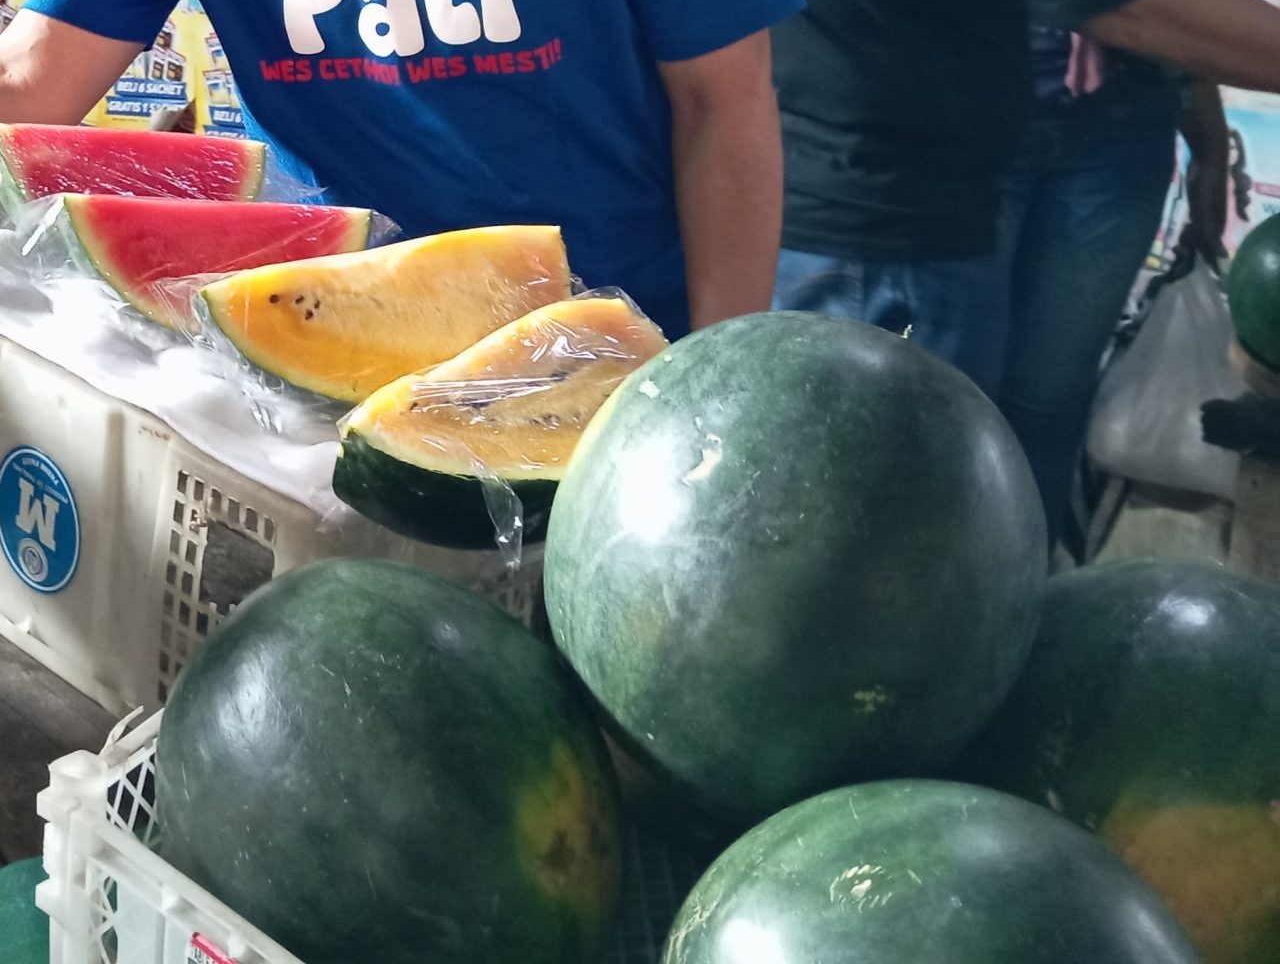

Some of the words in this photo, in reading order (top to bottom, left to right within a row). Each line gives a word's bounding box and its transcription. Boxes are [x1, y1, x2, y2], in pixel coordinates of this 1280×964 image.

[261, 60, 313, 83] WES
[406, 56, 467, 83] WES
[473, 38, 562, 75] MESTI!
[138, 82, 145, 93] 6
[145, 83, 183, 95] SACHET
[109, 100, 142, 112] GRATIS
